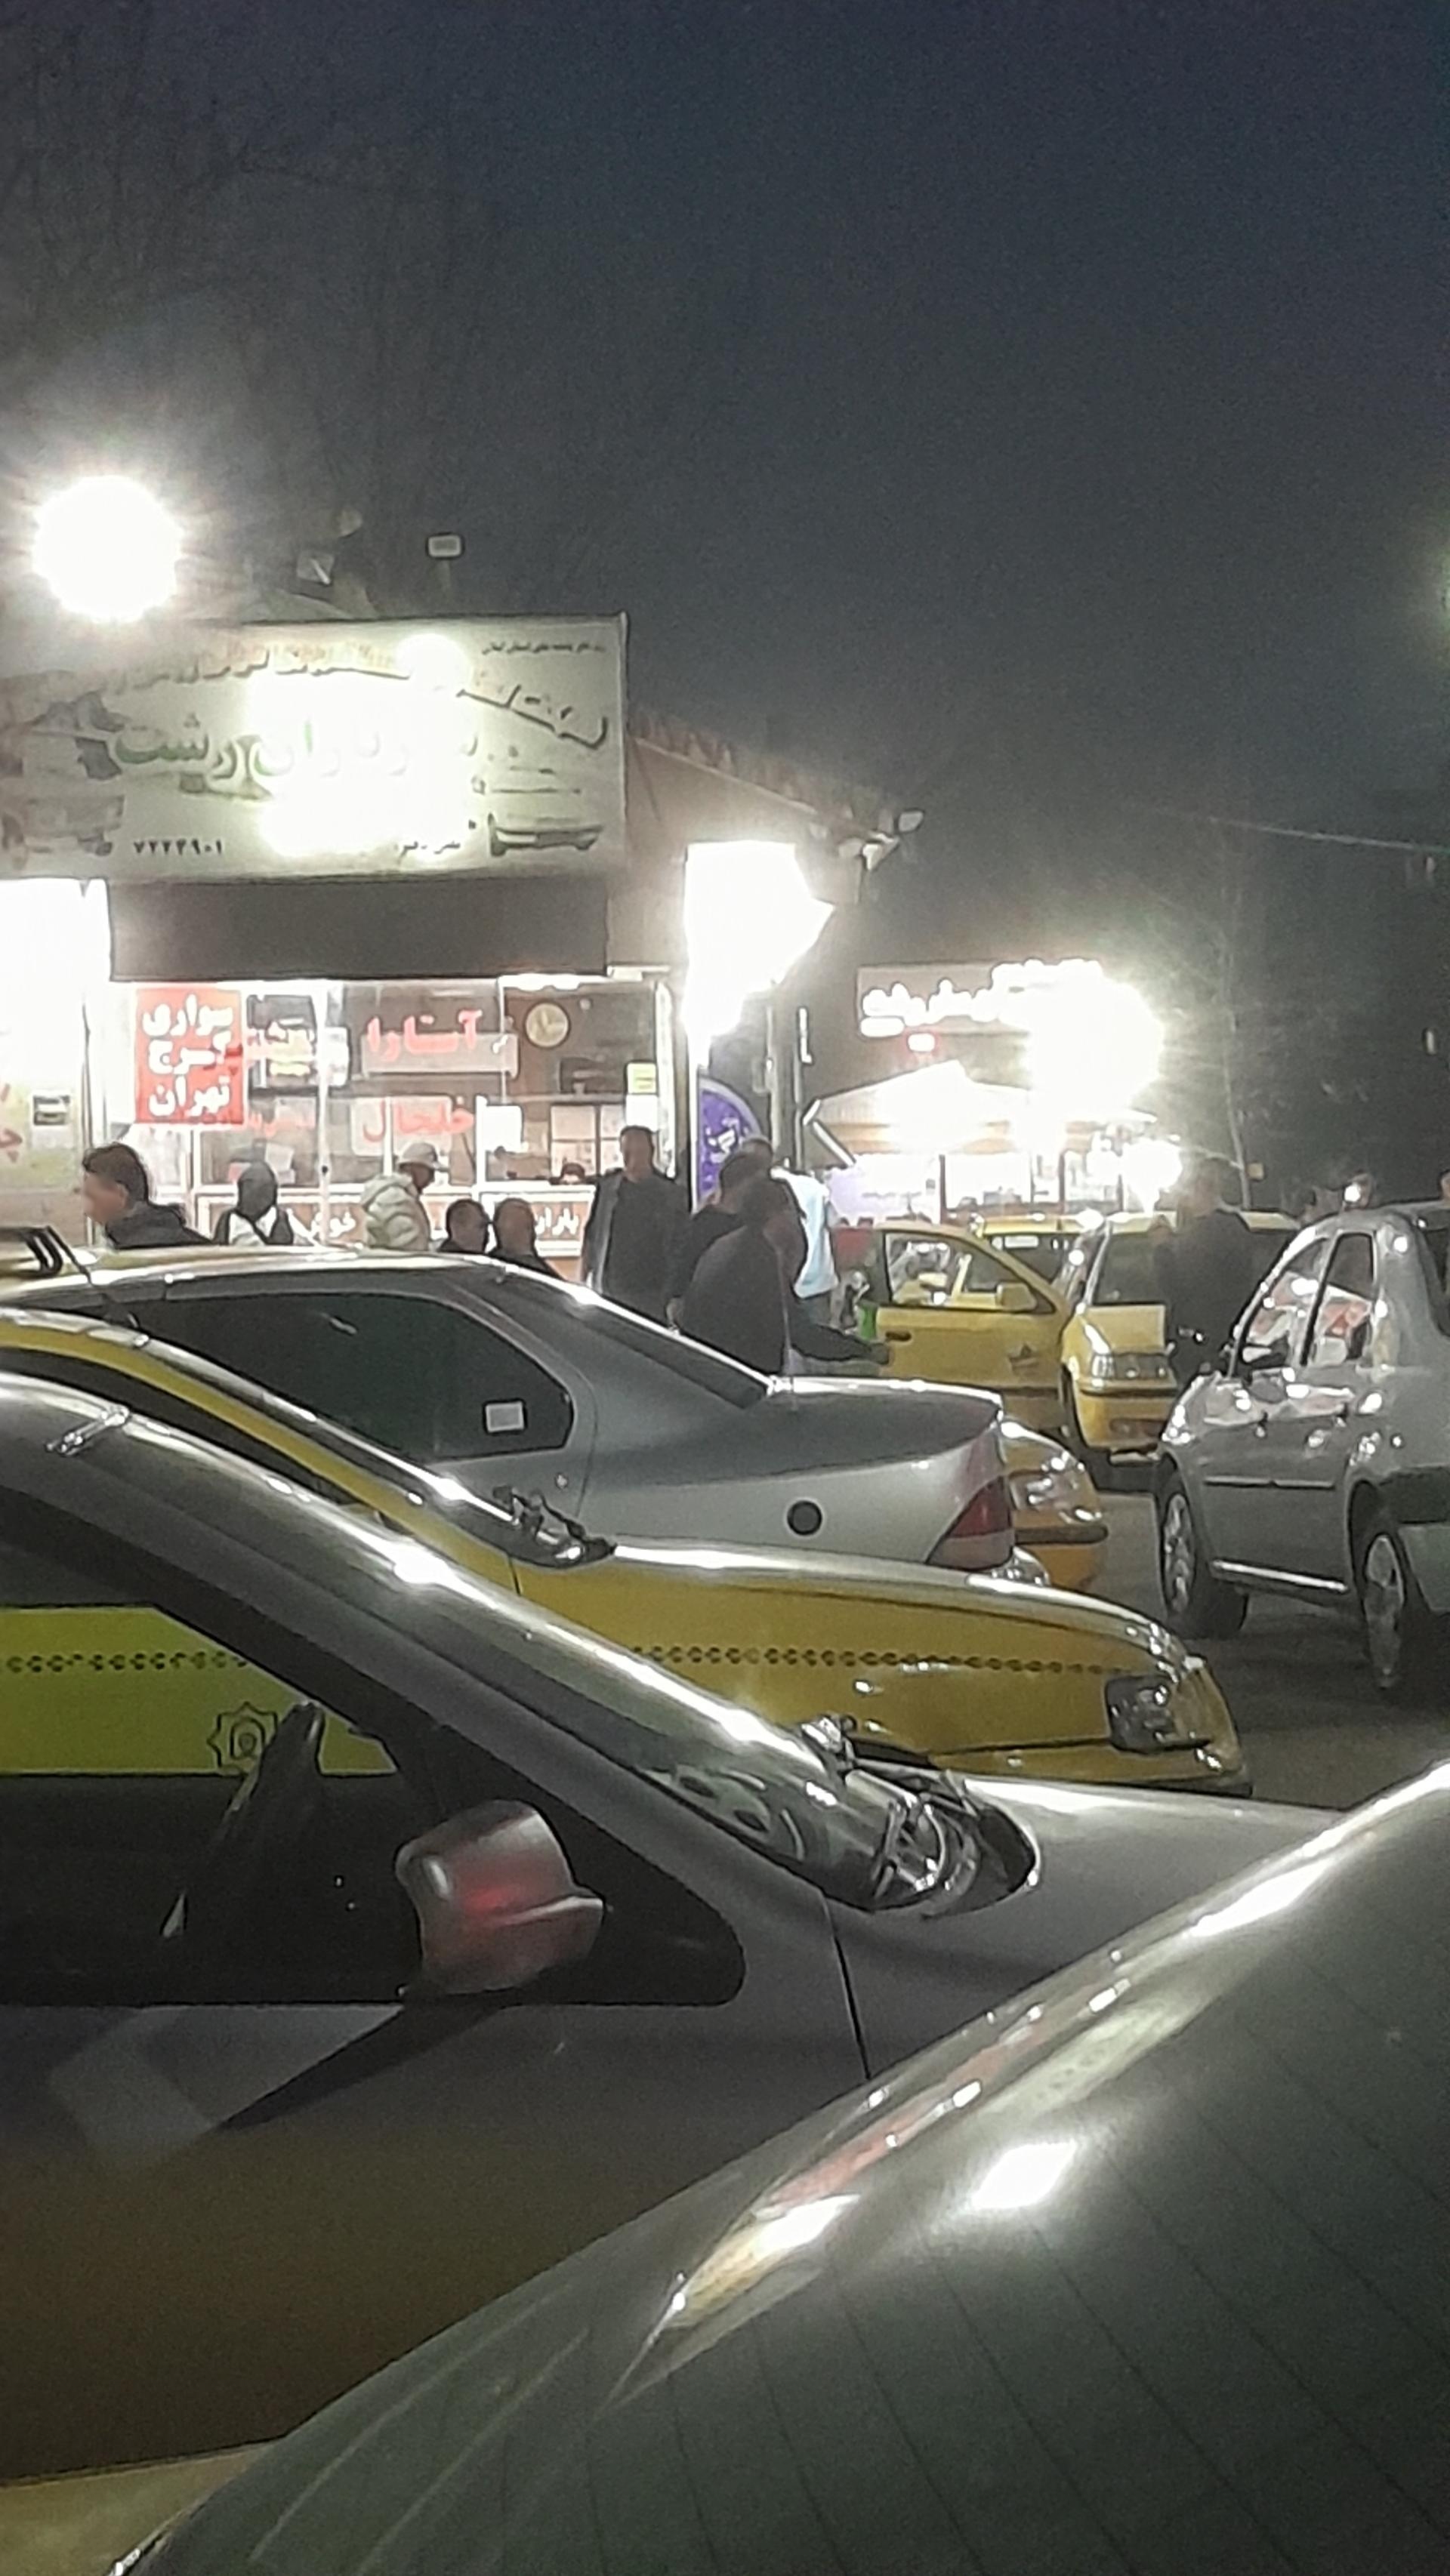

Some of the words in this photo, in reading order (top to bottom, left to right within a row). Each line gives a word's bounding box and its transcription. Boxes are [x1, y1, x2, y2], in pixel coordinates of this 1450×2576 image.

[142, 993, 233, 1037] سواری
[366, 1009, 483, 1063] آستارا
[148, 1030, 233, 1075] کرج
[148, 1074, 231, 1117] تهران
